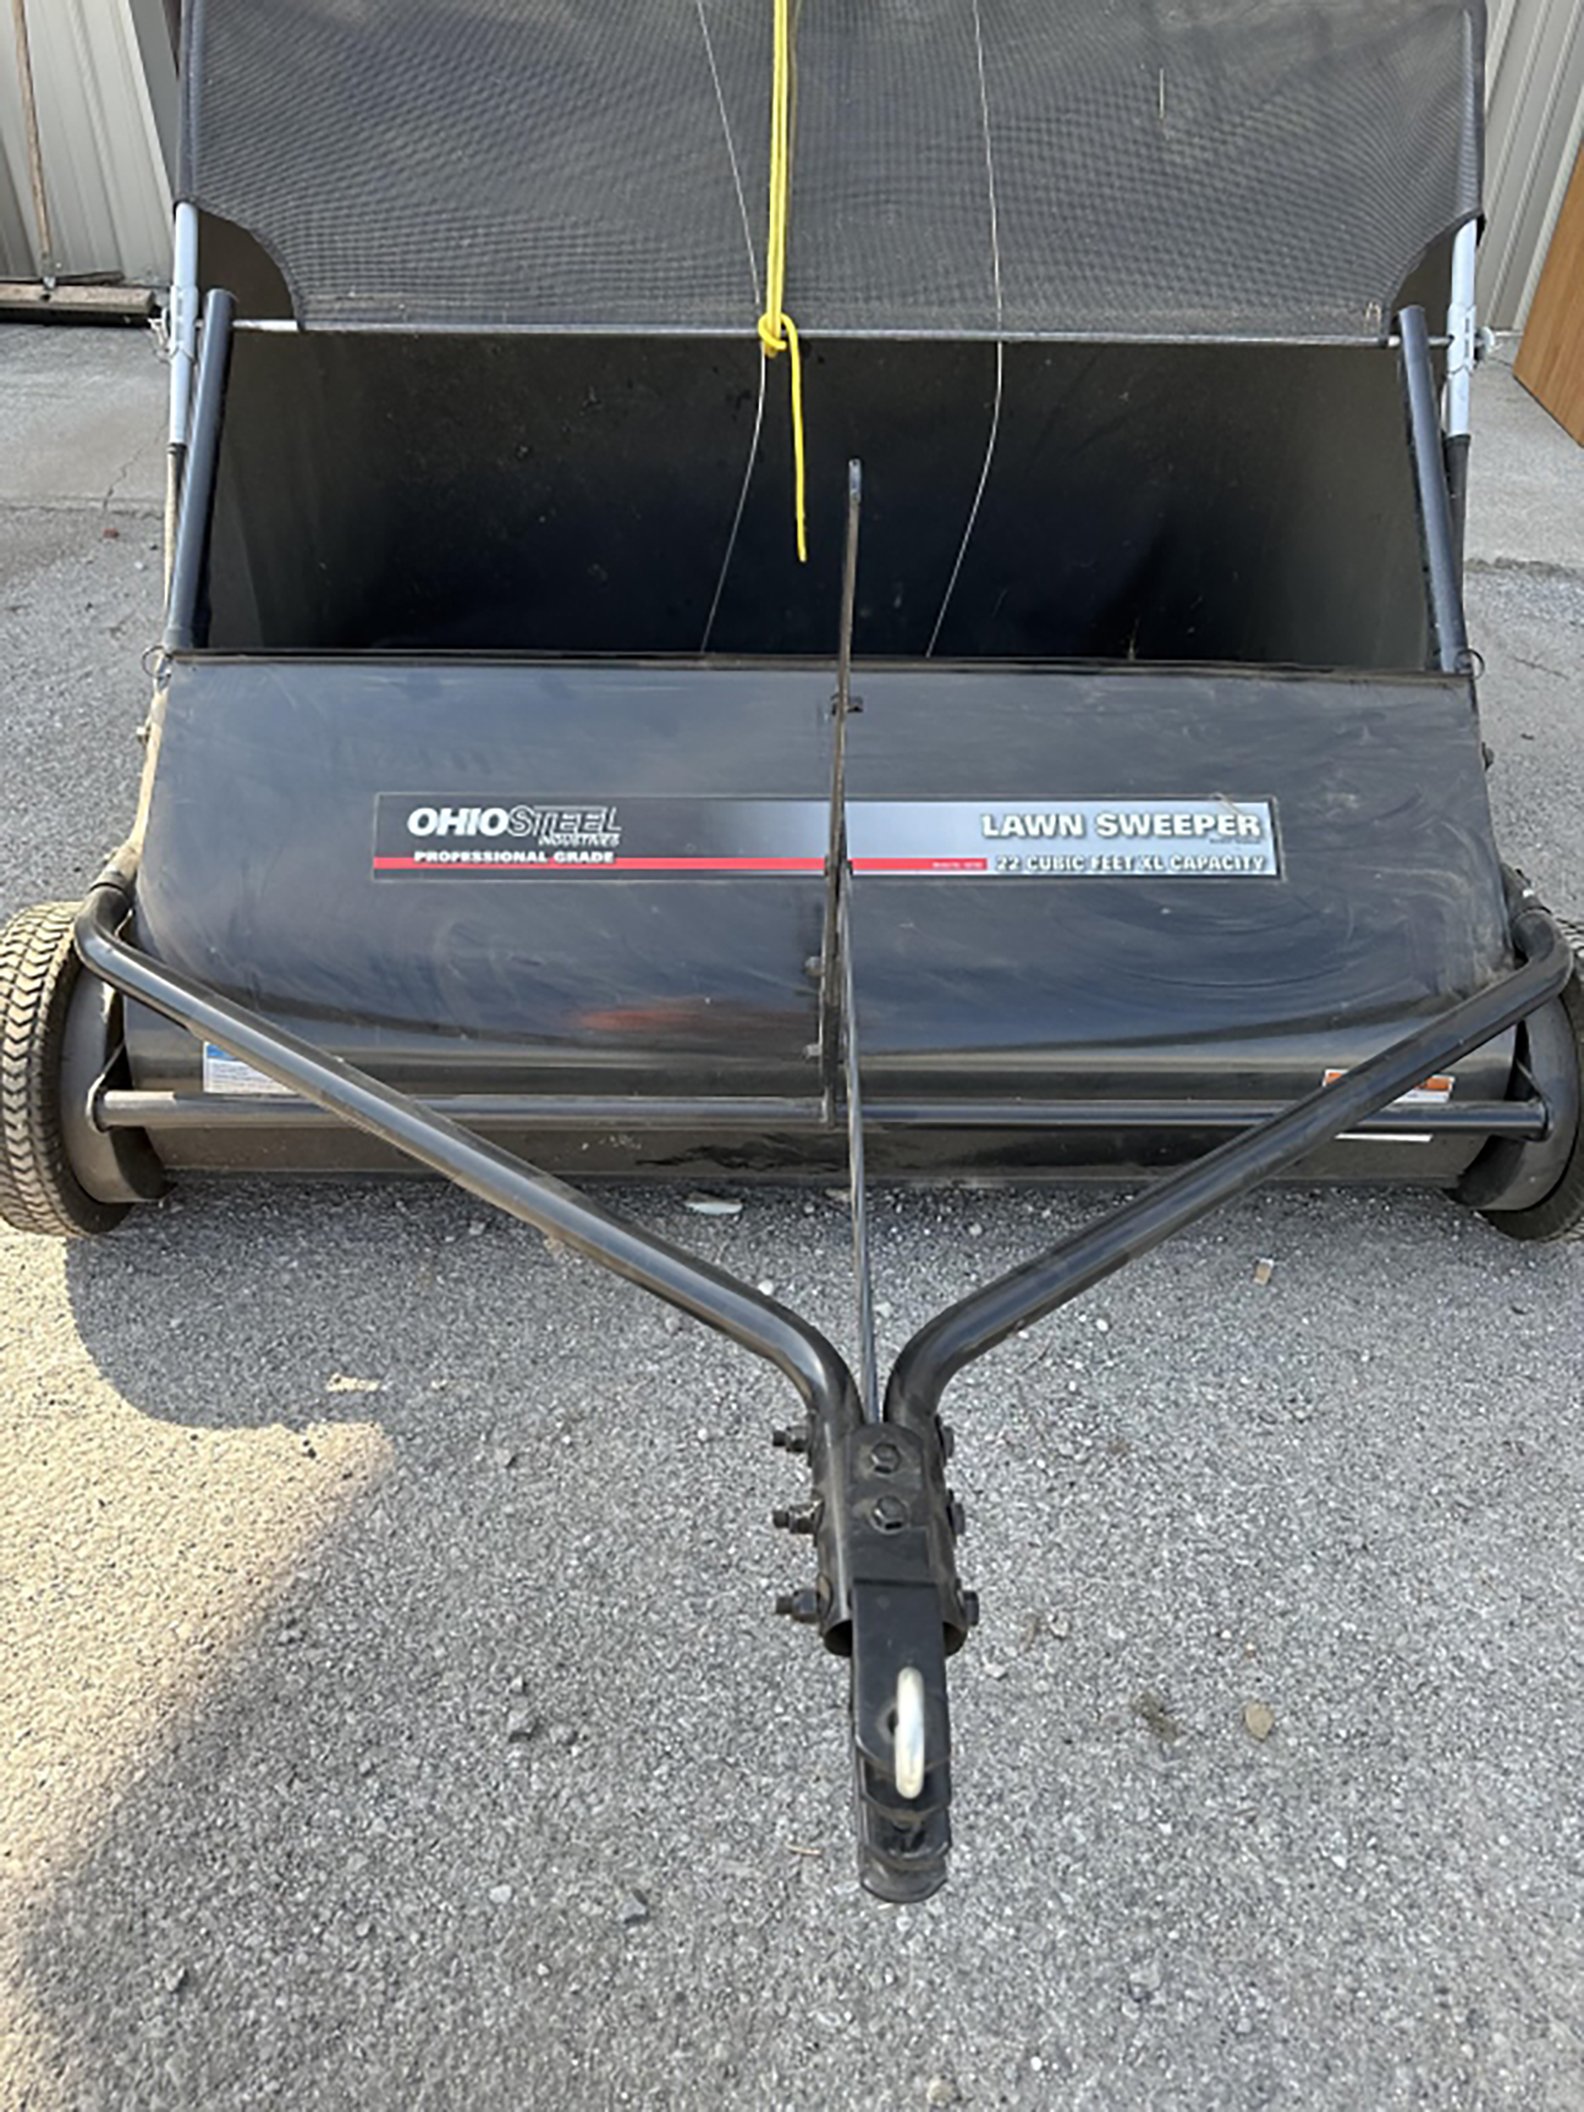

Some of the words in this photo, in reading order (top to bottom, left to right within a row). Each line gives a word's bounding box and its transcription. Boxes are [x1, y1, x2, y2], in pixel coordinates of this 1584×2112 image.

[982, 814, 1083, 836] LAWN
[1096, 814, 1261, 837] SWEEPER
[413, 850, 548, 864] PROFESSIONAL
[553, 850, 615, 864] GRADE
[997, 856, 1020, 872] 22
[1027, 856, 1083, 872] CUBIC
[1091, 856, 1133, 872] FEET
[1141, 856, 1165, 872] XL
[1170, 856, 1265, 873] CAPACITY
